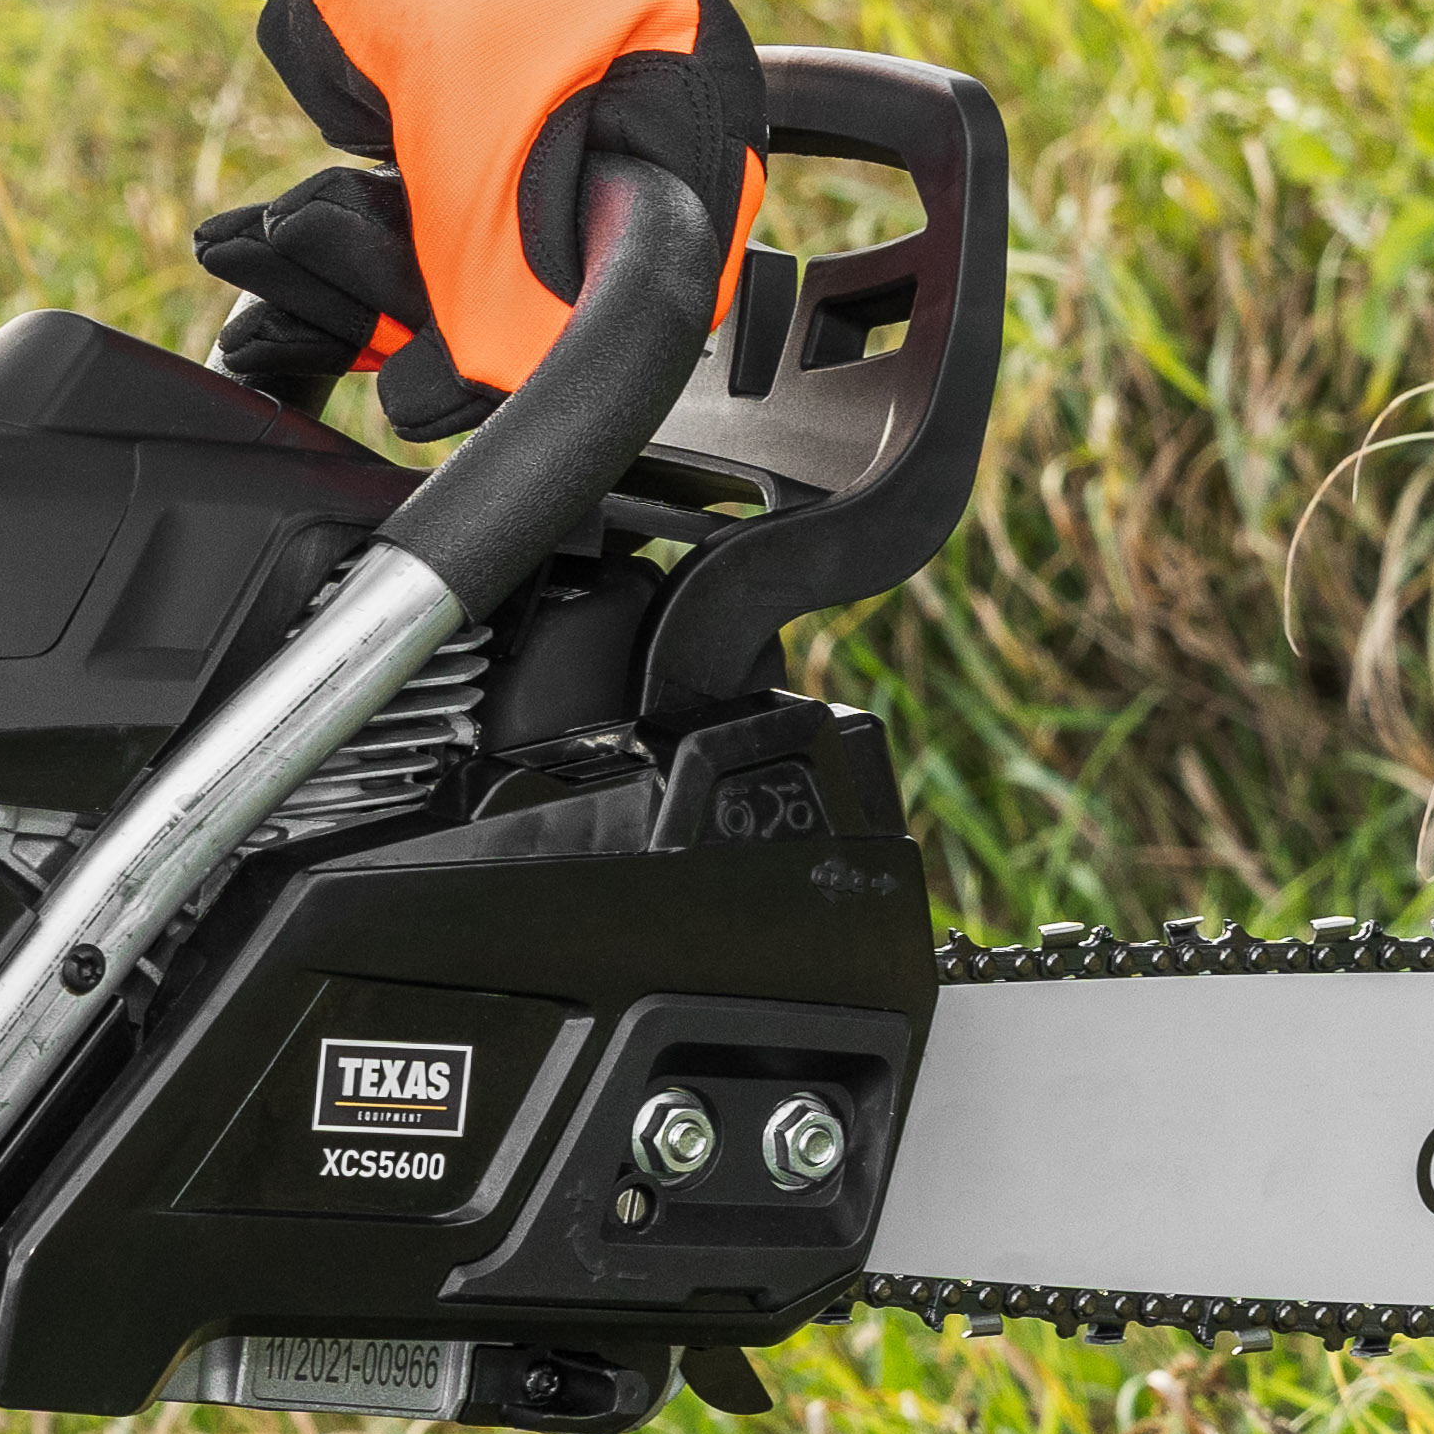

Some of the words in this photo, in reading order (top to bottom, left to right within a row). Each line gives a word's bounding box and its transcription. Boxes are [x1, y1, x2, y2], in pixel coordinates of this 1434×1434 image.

[338, 1056, 451, 1100] TEXAS
[357, 1110, 422, 1123] EQUIPMENT
[319, 1147, 446, 1180] XCS5600
[265, 1337, 441, 1389] 11/2021-00966
